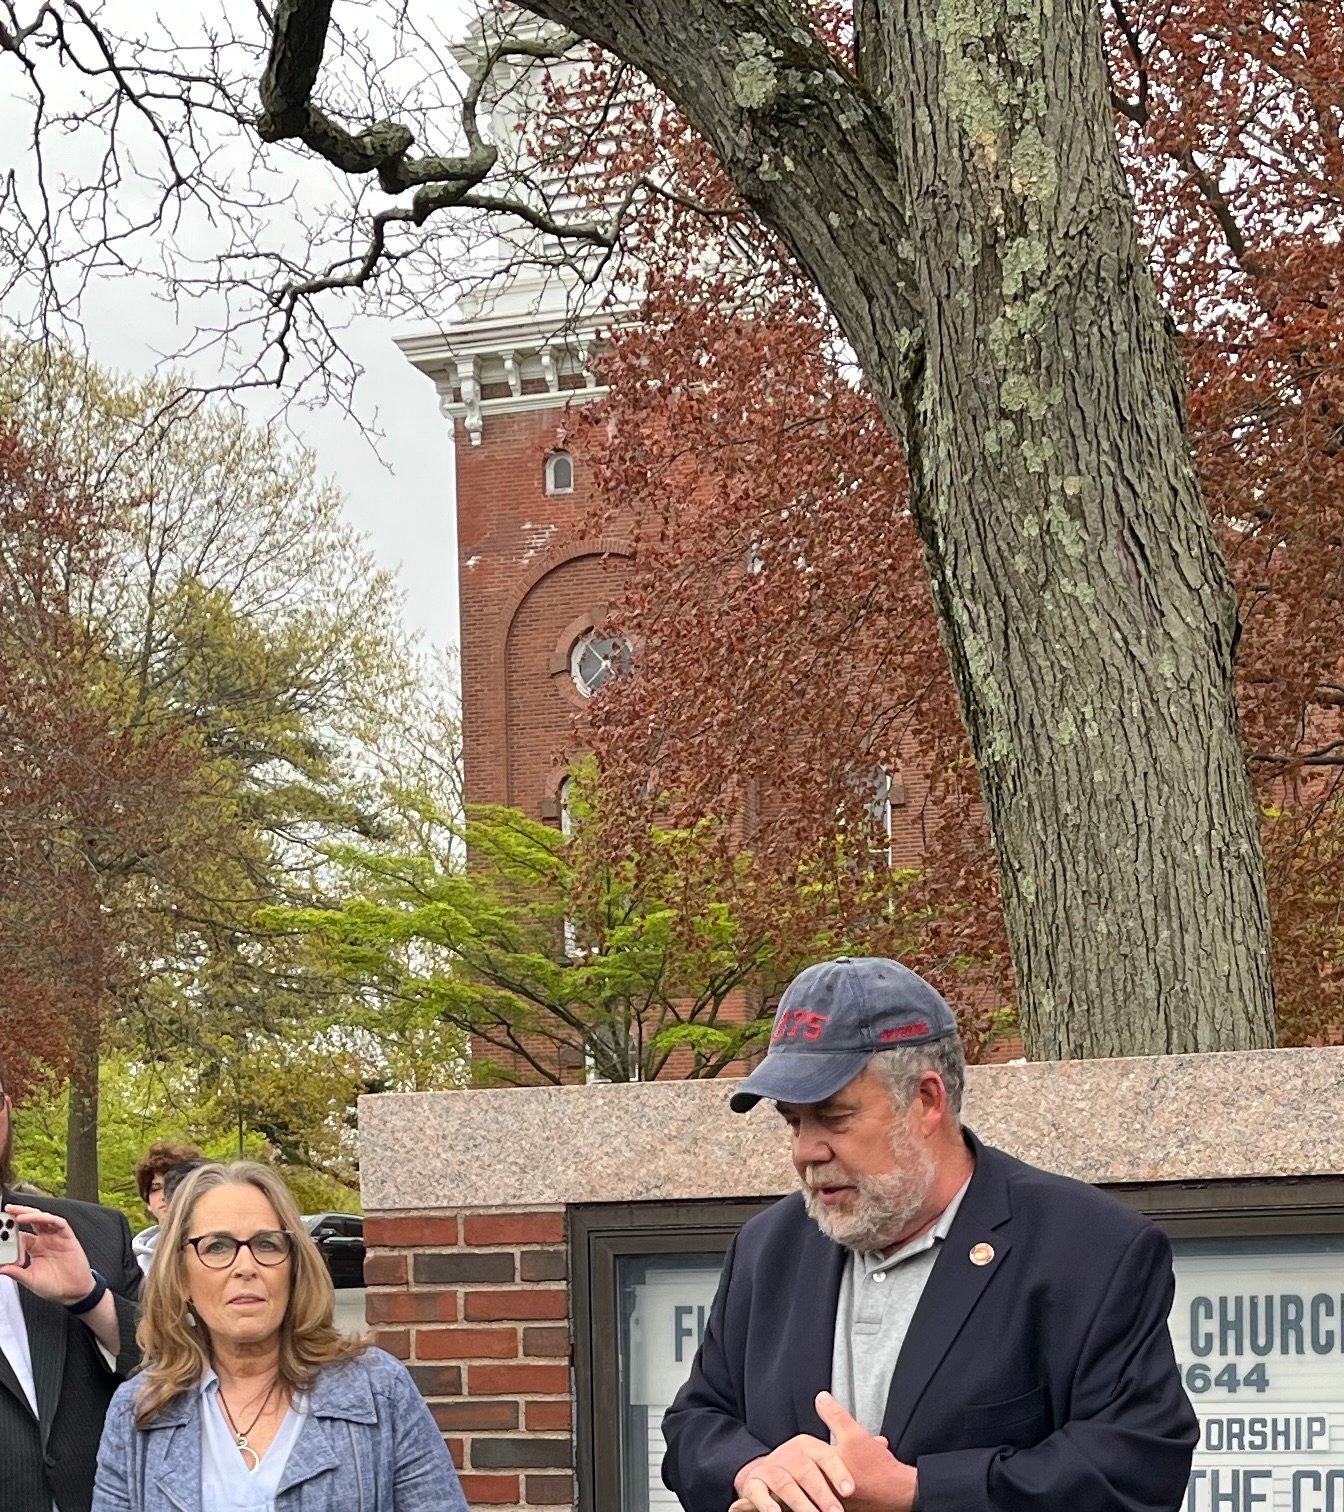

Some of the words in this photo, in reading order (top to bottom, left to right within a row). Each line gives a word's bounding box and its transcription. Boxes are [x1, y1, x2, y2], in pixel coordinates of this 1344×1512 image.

[674, 1305, 705, 1362] FI
[1177, 1362, 1270, 1394] 644
[1197, 1416, 1327, 1451] ORSHIP
